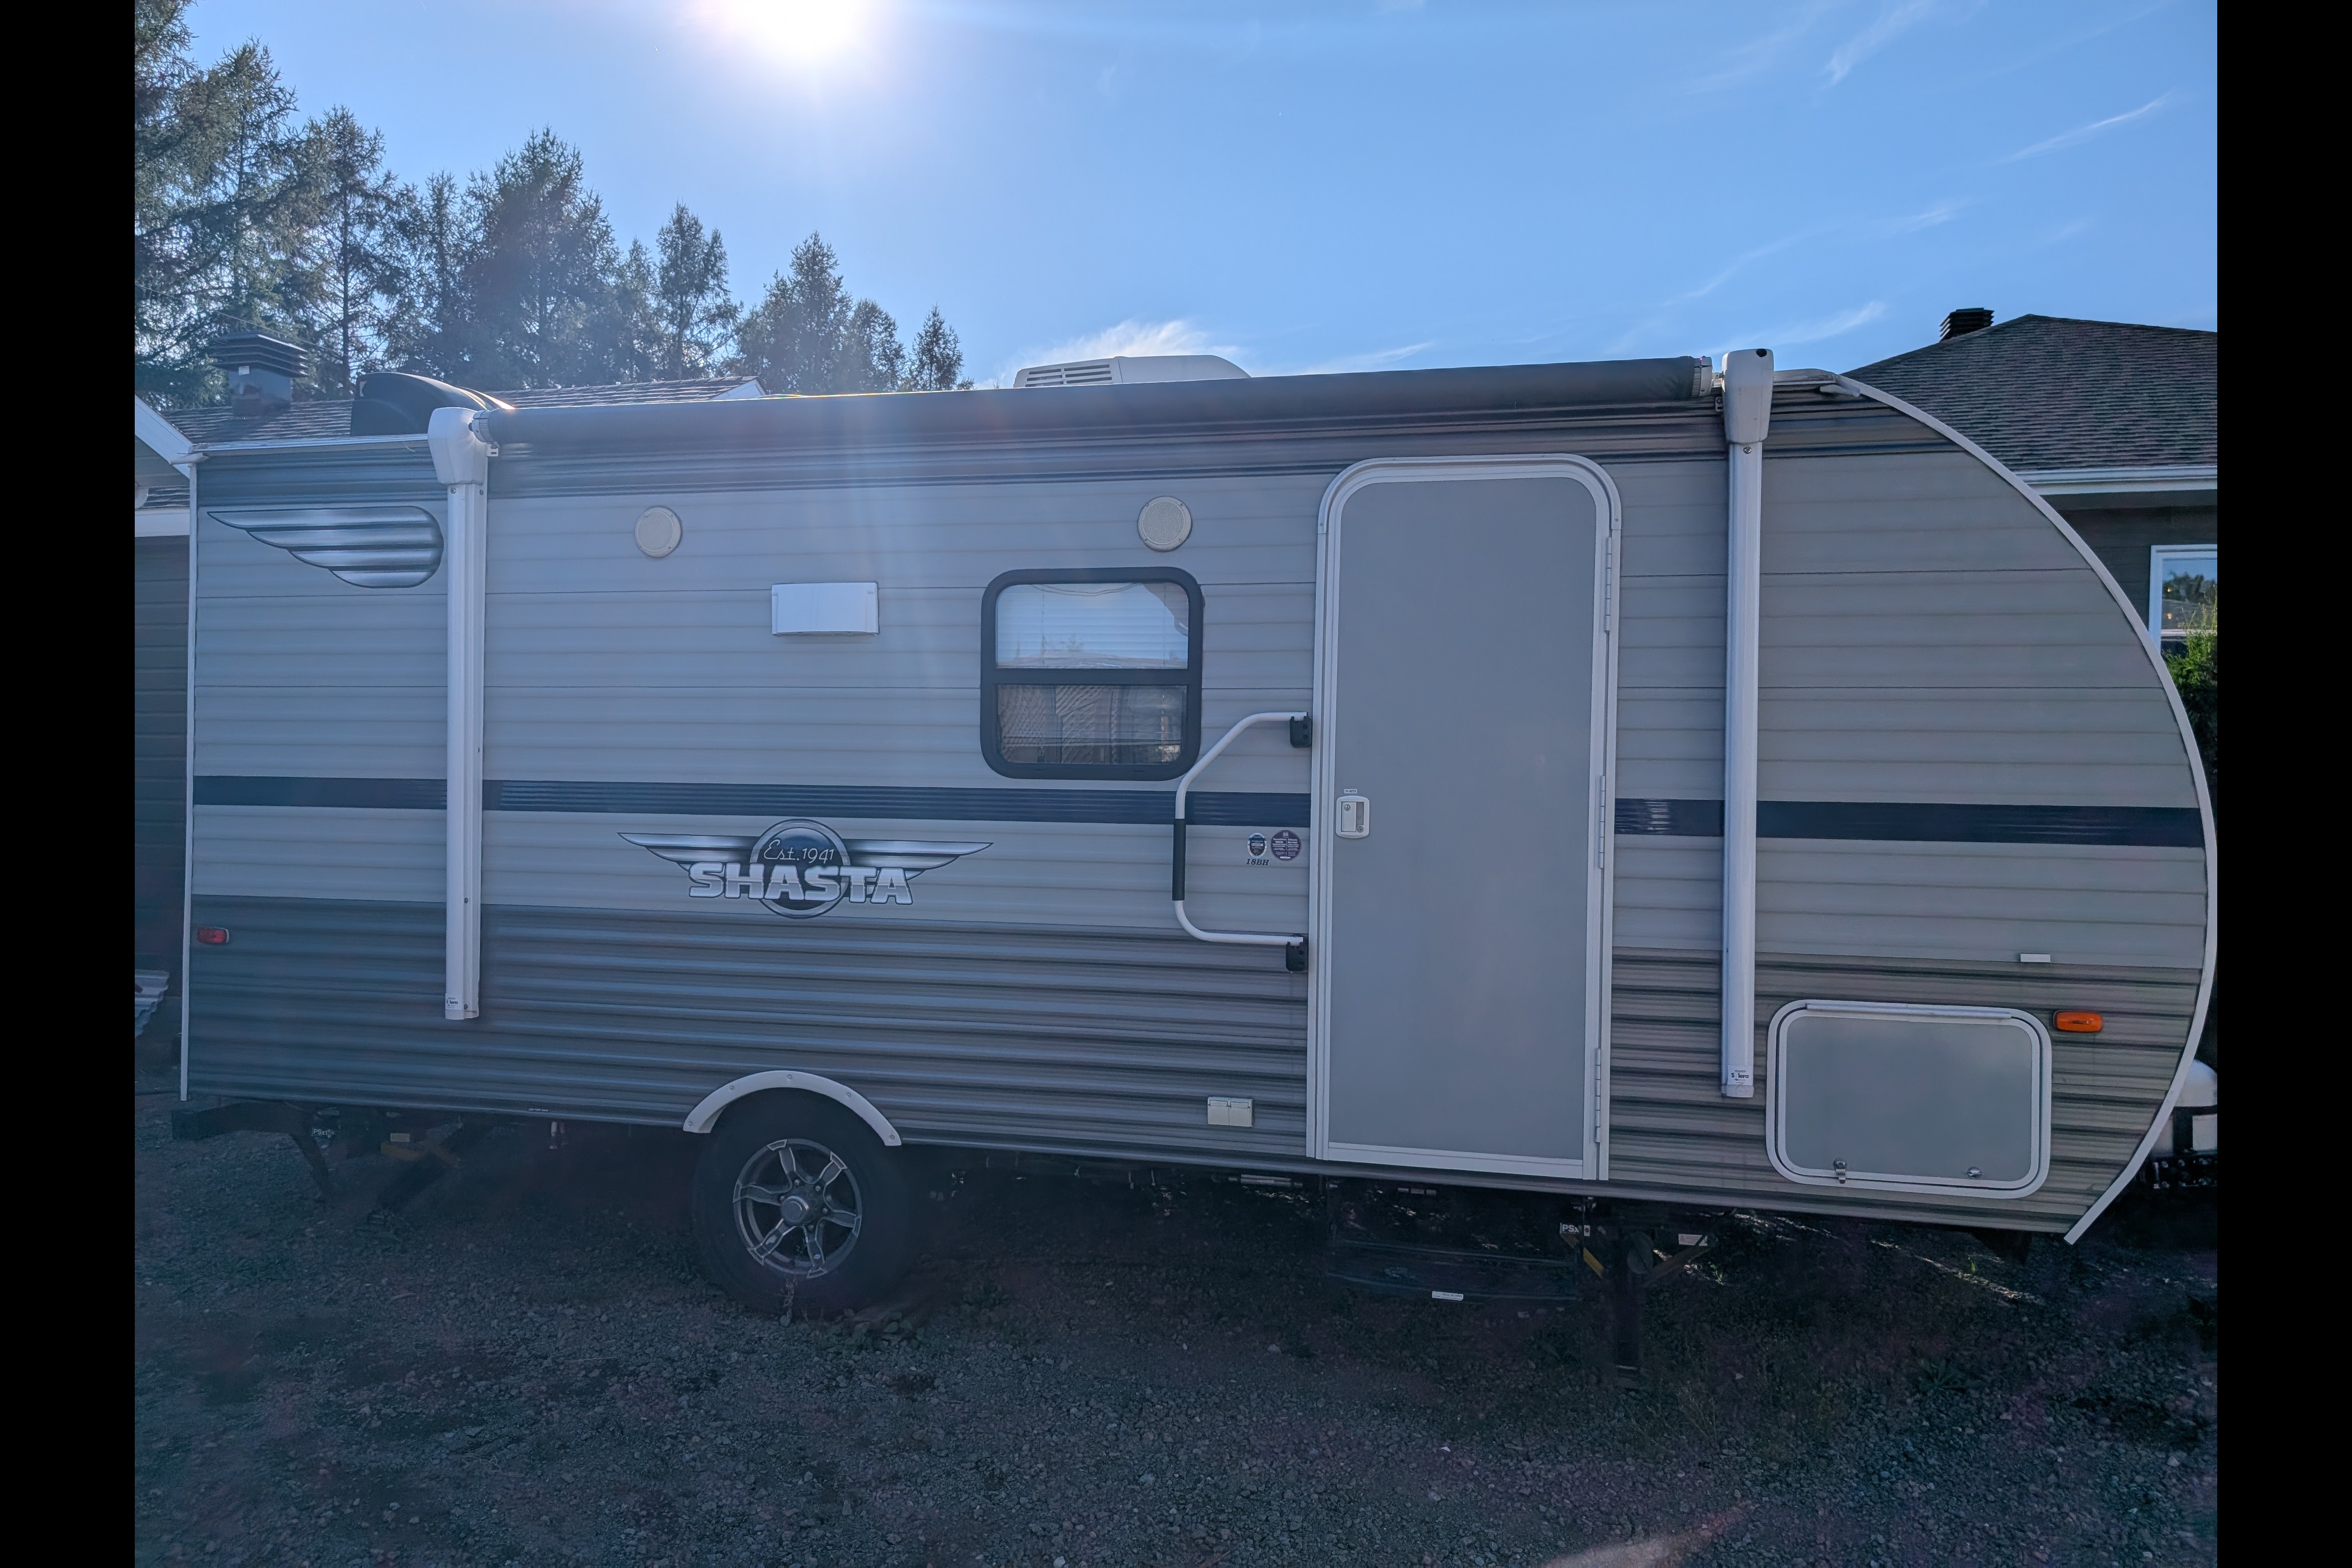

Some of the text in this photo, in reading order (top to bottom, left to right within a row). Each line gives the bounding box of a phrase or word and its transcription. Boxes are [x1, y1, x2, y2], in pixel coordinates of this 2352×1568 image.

[764, 839, 835, 865] Est. 1941
[688, 862, 914, 905] SHASTA
